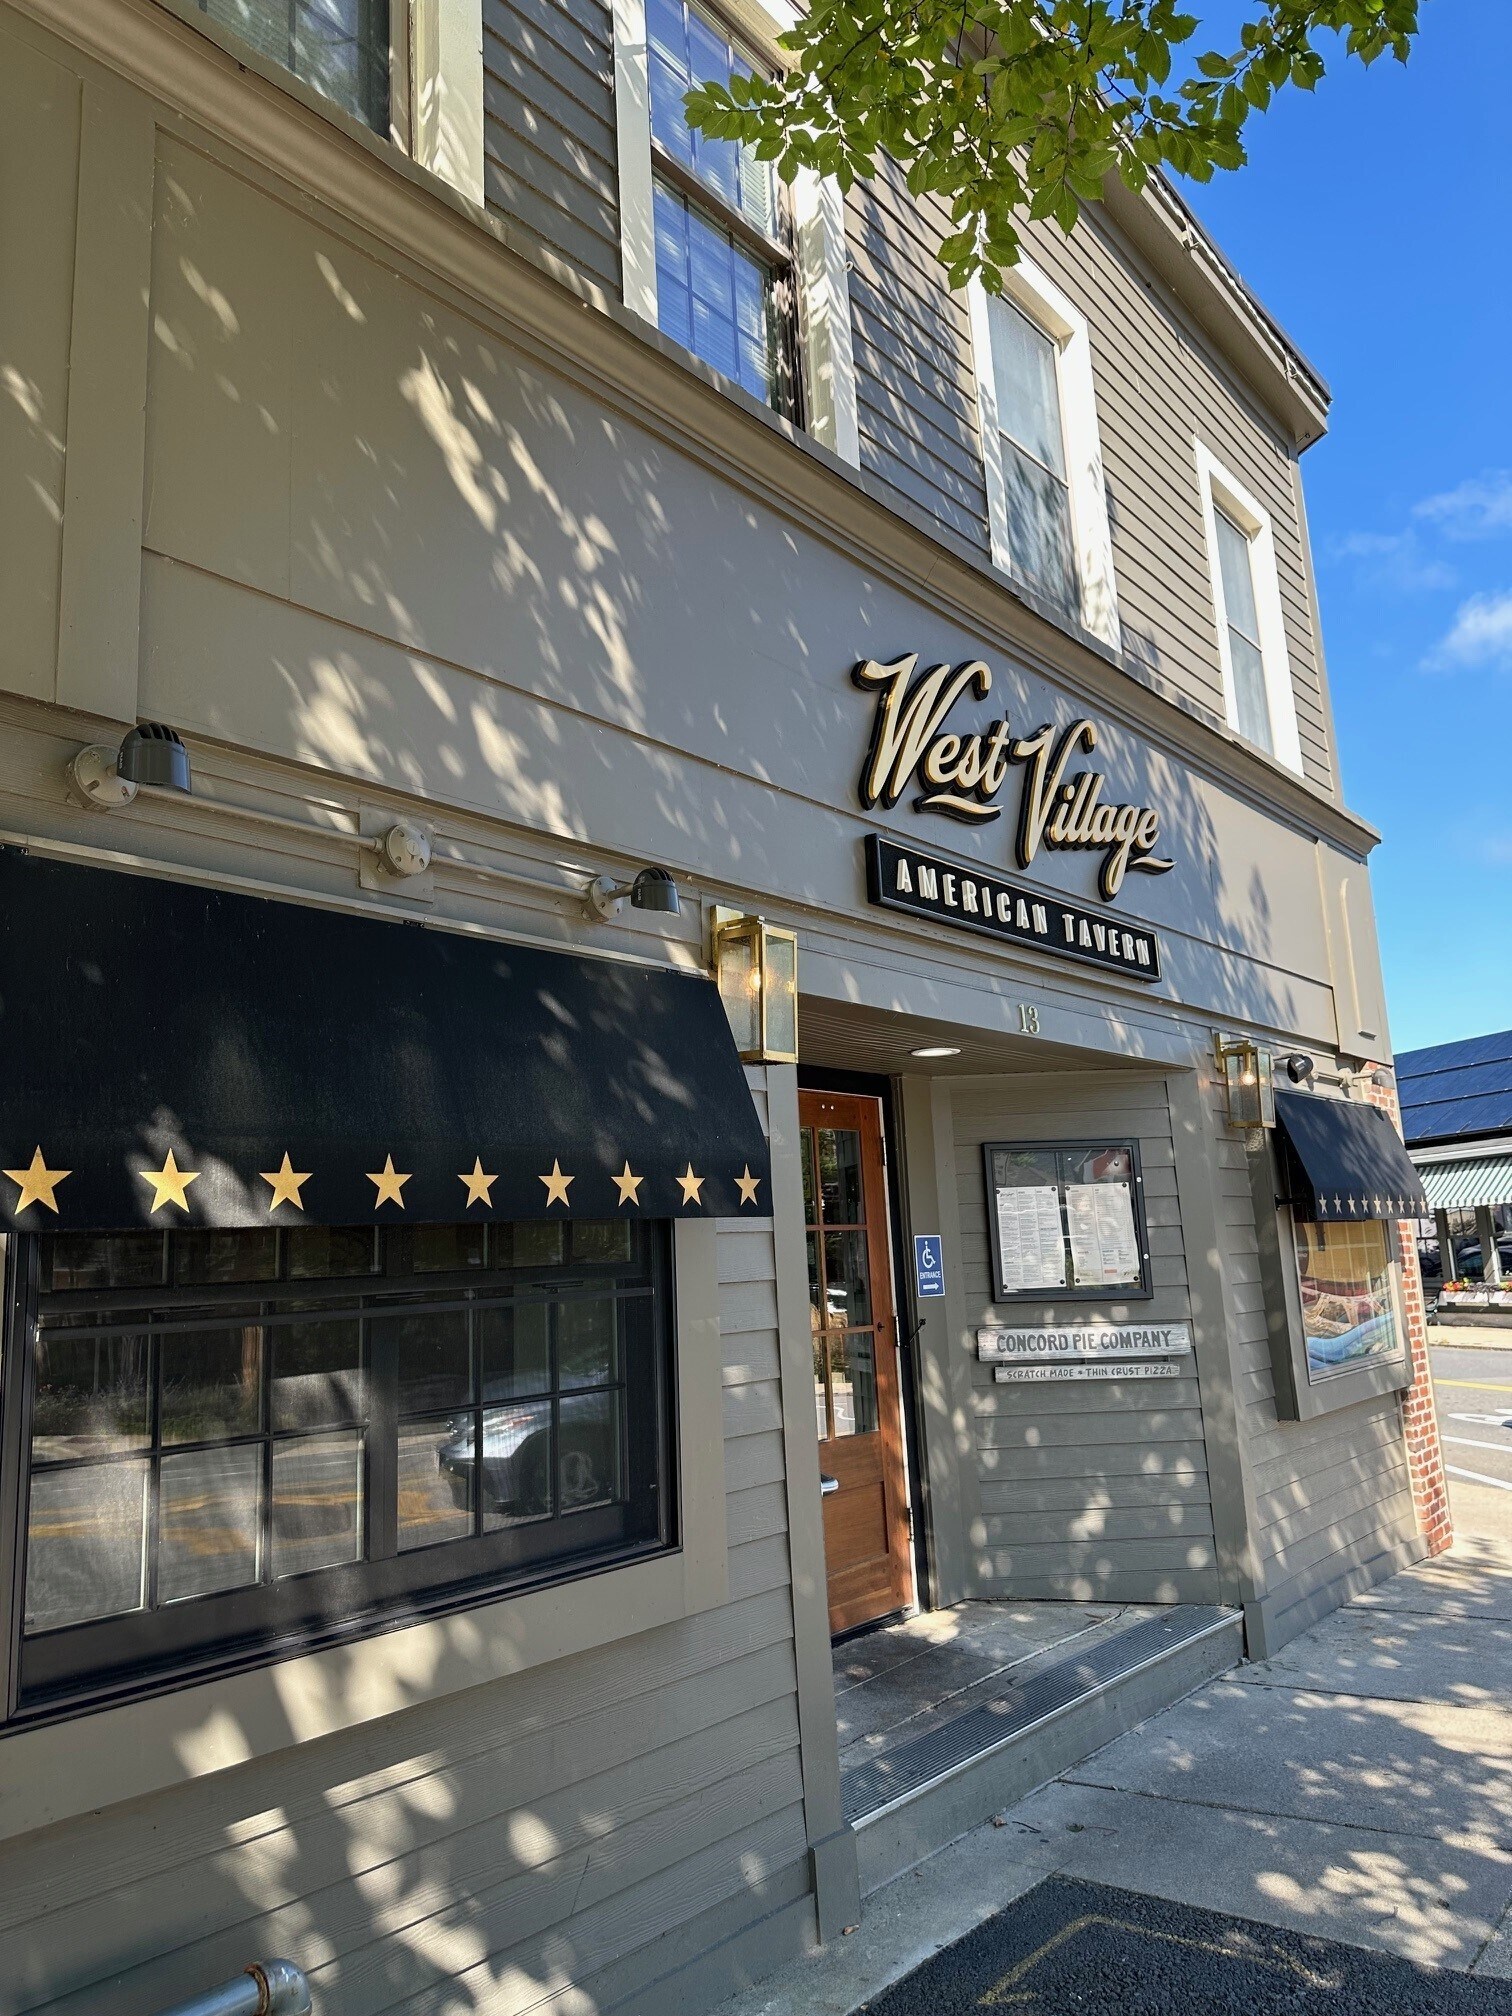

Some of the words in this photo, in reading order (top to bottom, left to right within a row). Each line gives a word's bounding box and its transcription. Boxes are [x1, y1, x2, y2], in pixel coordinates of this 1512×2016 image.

[852, 652, 1010, 818] West
[1009, 718, 1176, 901] Village
[896, 858, 1048, 935] AMERICAN
[1061, 913, 1151, 966] TAVERN
[1017, 1003, 1041, 1035] 13
[919, 1270, 942, 1280] ENTRANCE
[996, 1333, 1069, 1353] CONCORD
[1072, 1333, 1097, 1350] PIE
[1101, 1330, 1172, 1350] COMPANY
[1006, 1369, 1046, 1379] SCRATCH
[1049, 1368, 1074, 1378] MADE
[1085, 1367, 1108, 1376] THIN
[1111, 1366, 1141, 1376] CRUST
[1144, 1365, 1172, 1376] PIZZA
